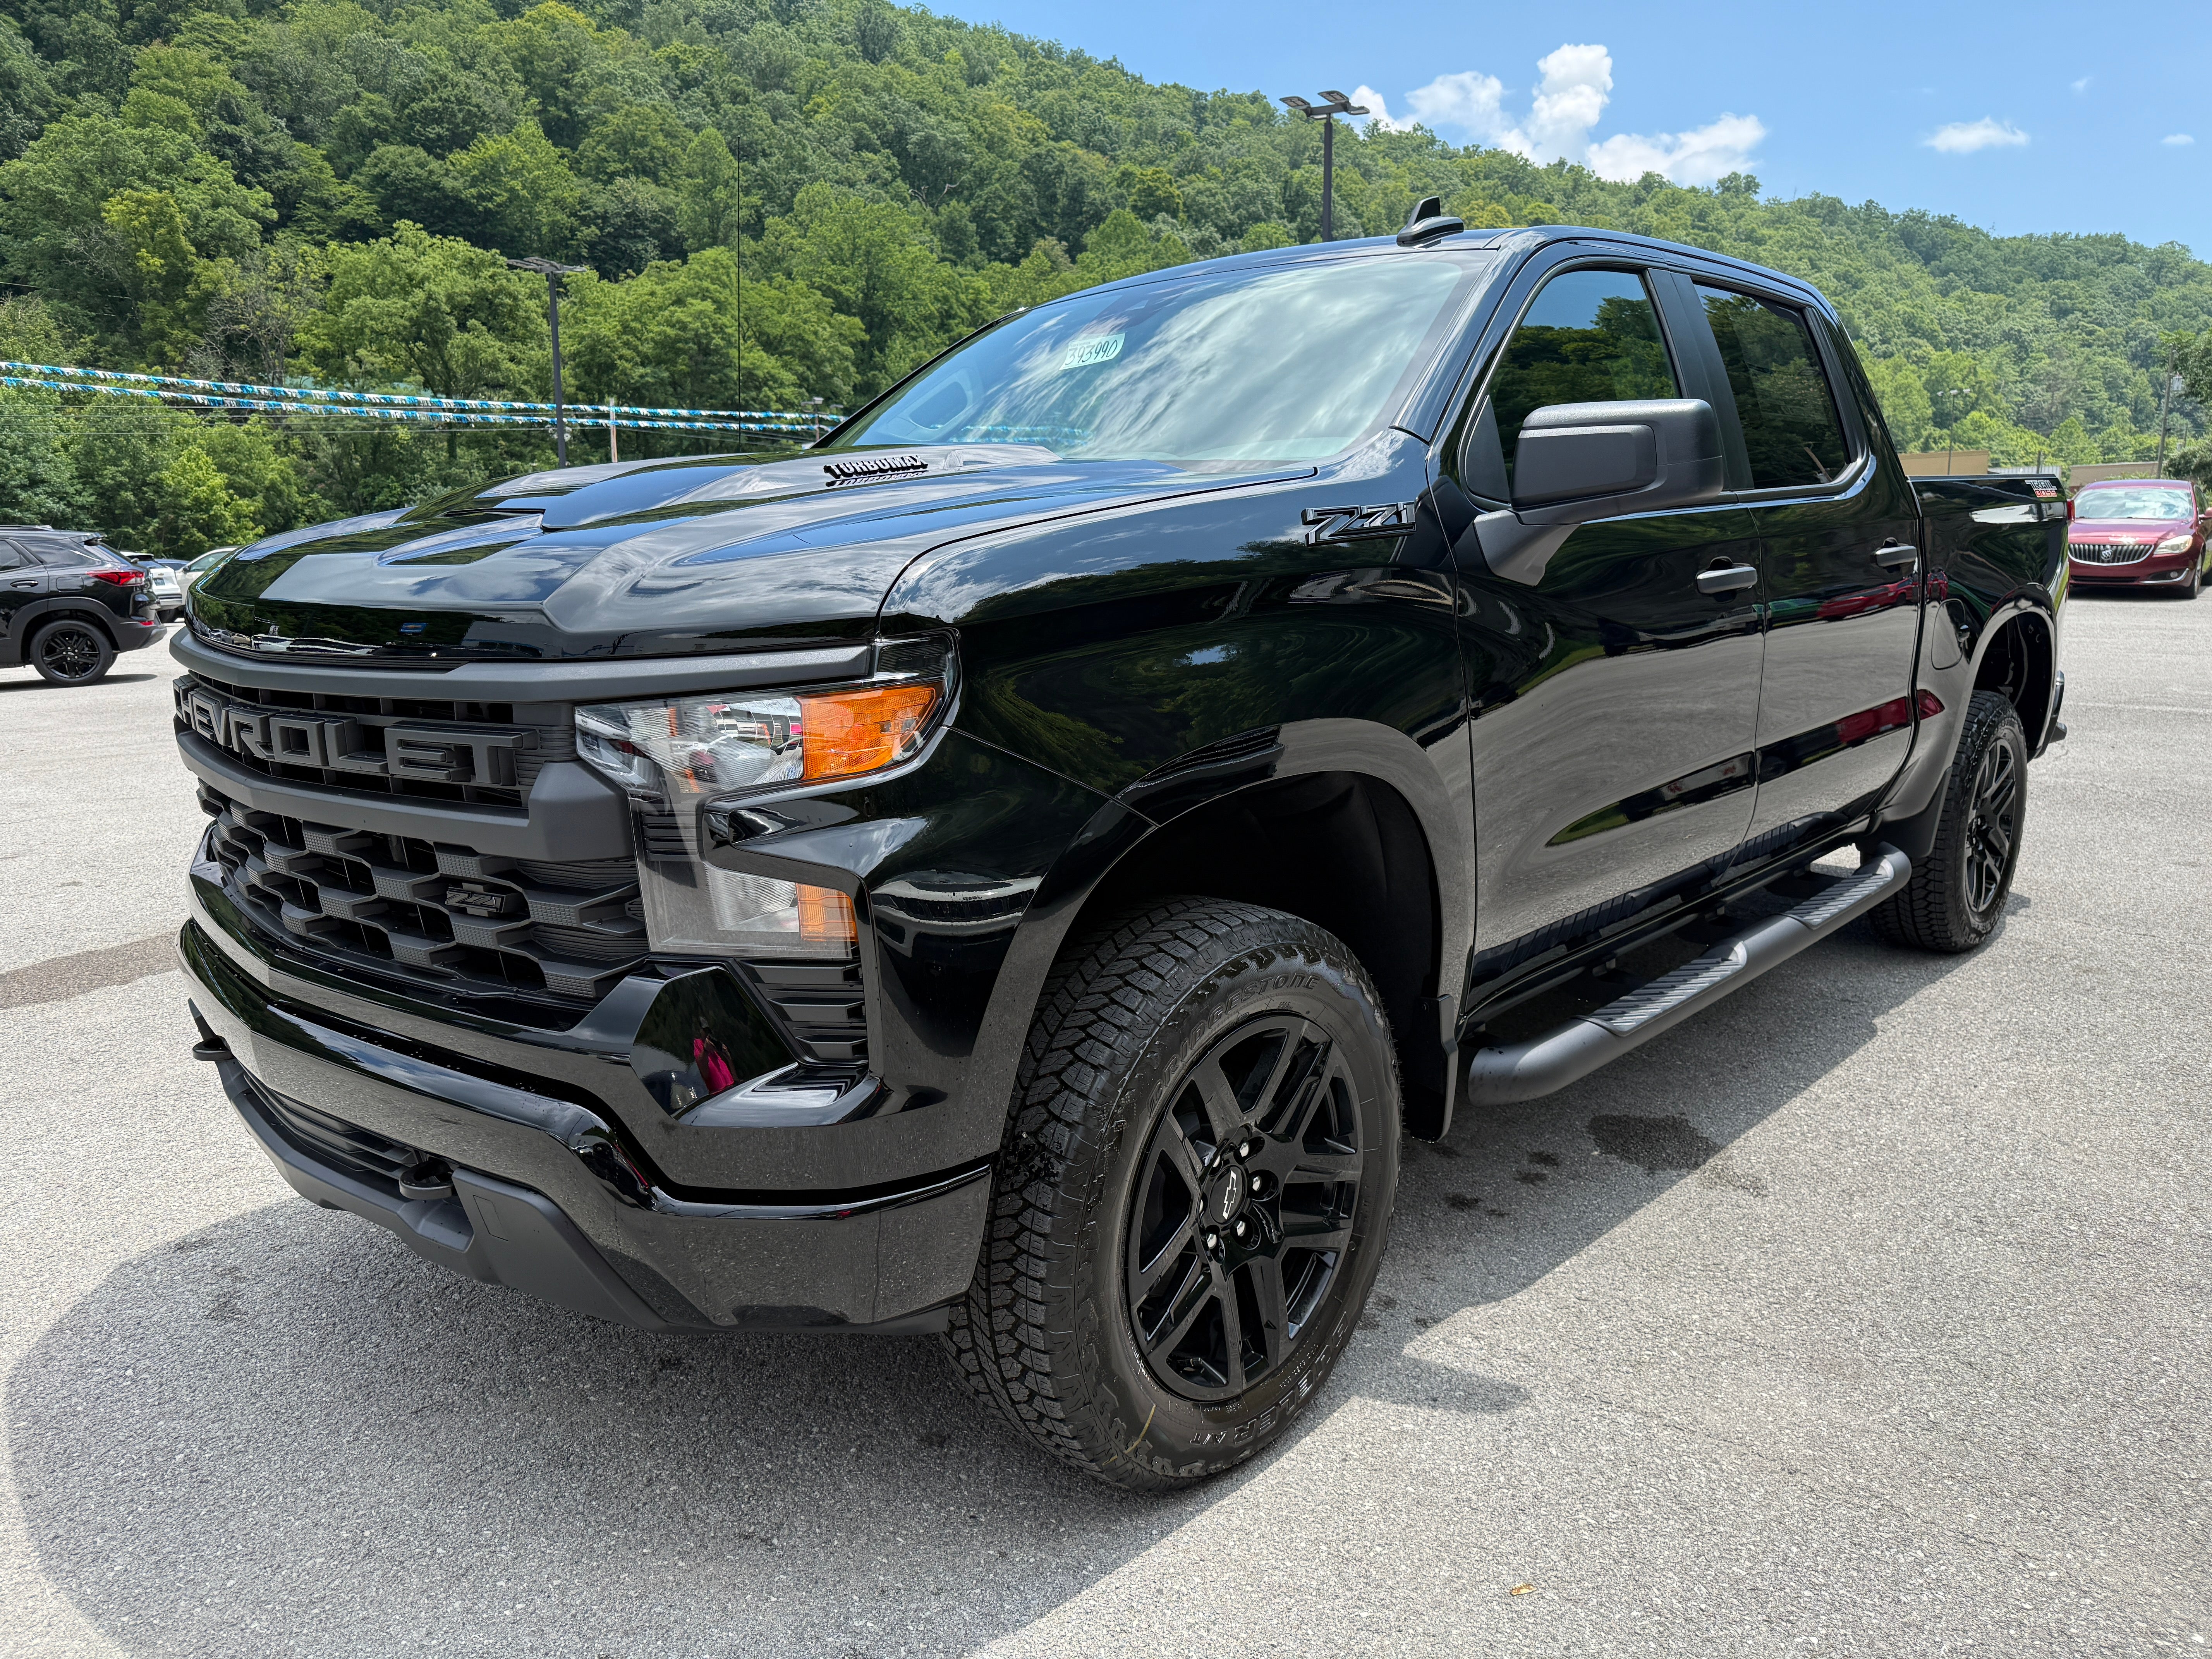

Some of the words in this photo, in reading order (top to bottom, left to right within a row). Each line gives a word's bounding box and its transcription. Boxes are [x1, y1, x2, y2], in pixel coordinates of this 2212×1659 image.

[1065, 339, 1118, 366] 393990
[824, 455, 929, 479] TURBOMAX
[2024, 480, 2057, 490] TRAIL
[2034, 489, 2057, 498] BOSS
[1300, 501, 1416, 547] Z71
[1146, 972, 1321, 1120] BRIDGESTONE
